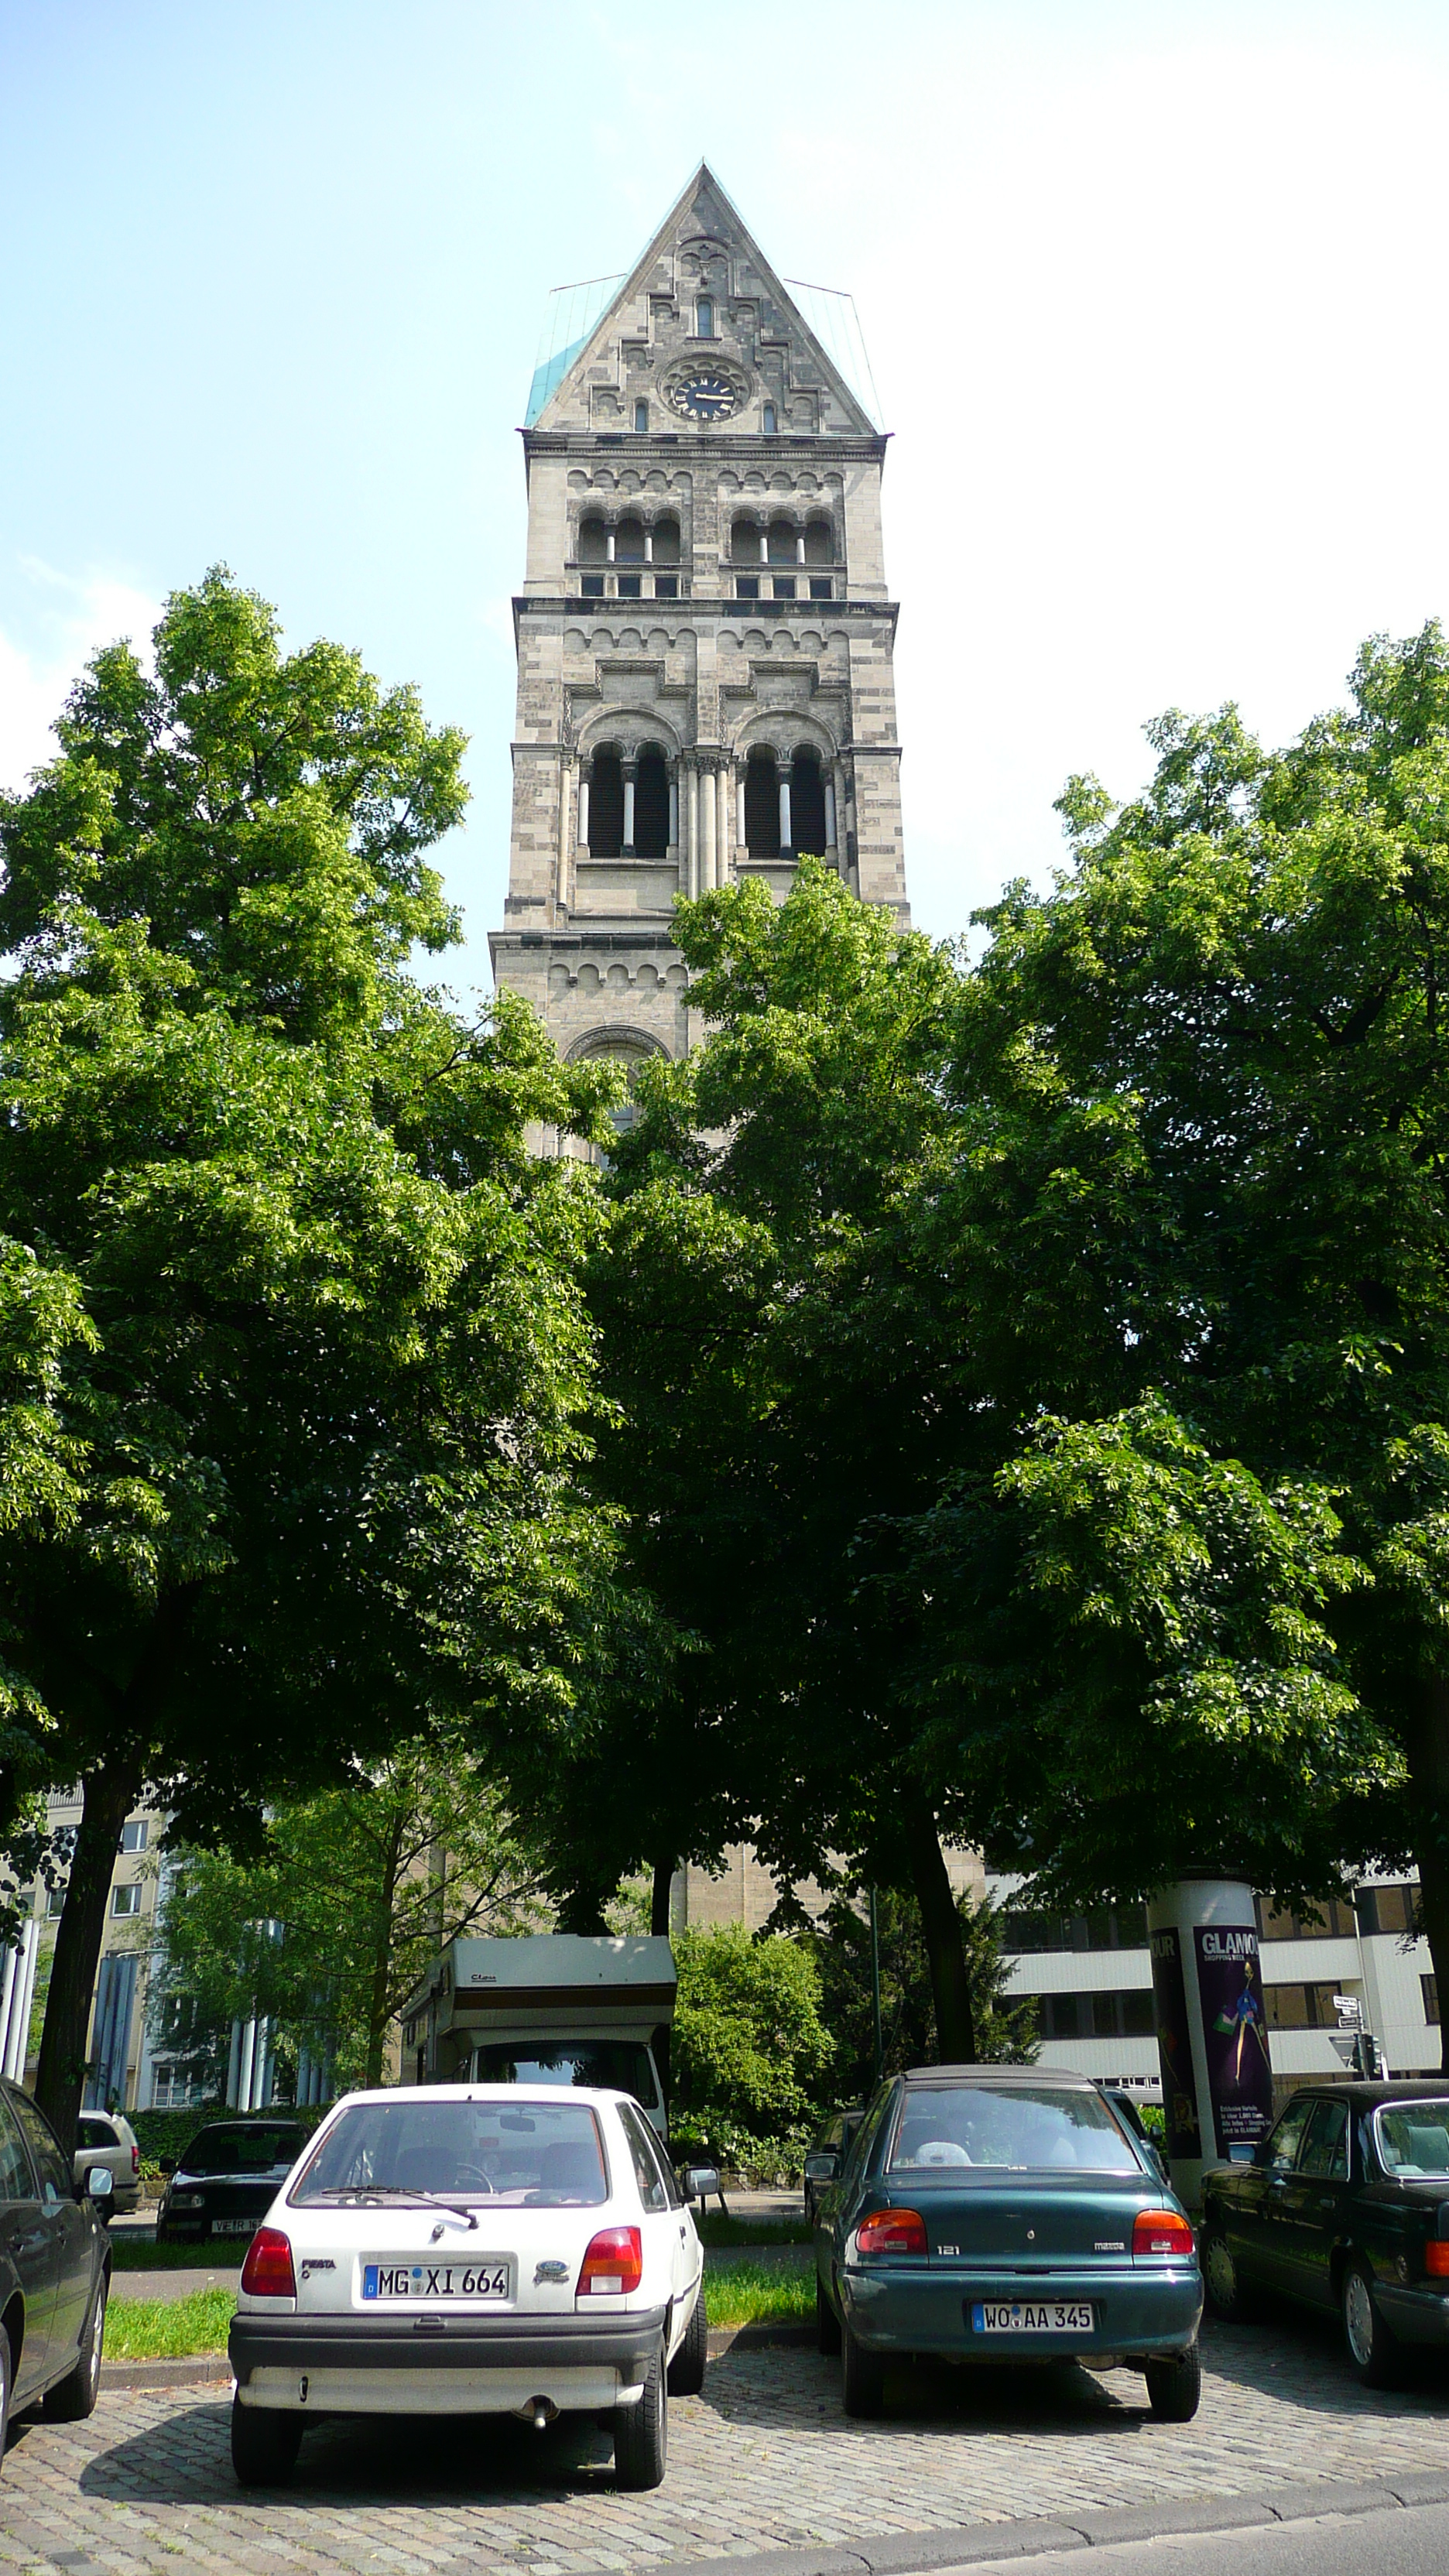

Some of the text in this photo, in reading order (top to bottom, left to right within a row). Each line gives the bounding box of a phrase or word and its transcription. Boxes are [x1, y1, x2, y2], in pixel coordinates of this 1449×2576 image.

[937, 2245, 960, 2256] 121
[301, 2259, 337, 2269] FIESTA
[379, 2269, 409, 2294] MG
[426, 2269, 454, 2294] XI
[462, 2269, 505, 2293] 664
[985, 2307, 1010, 2328] WO
[1024, 2307, 1050, 2328] AA
[1054, 2307, 1091, 2328] 345
